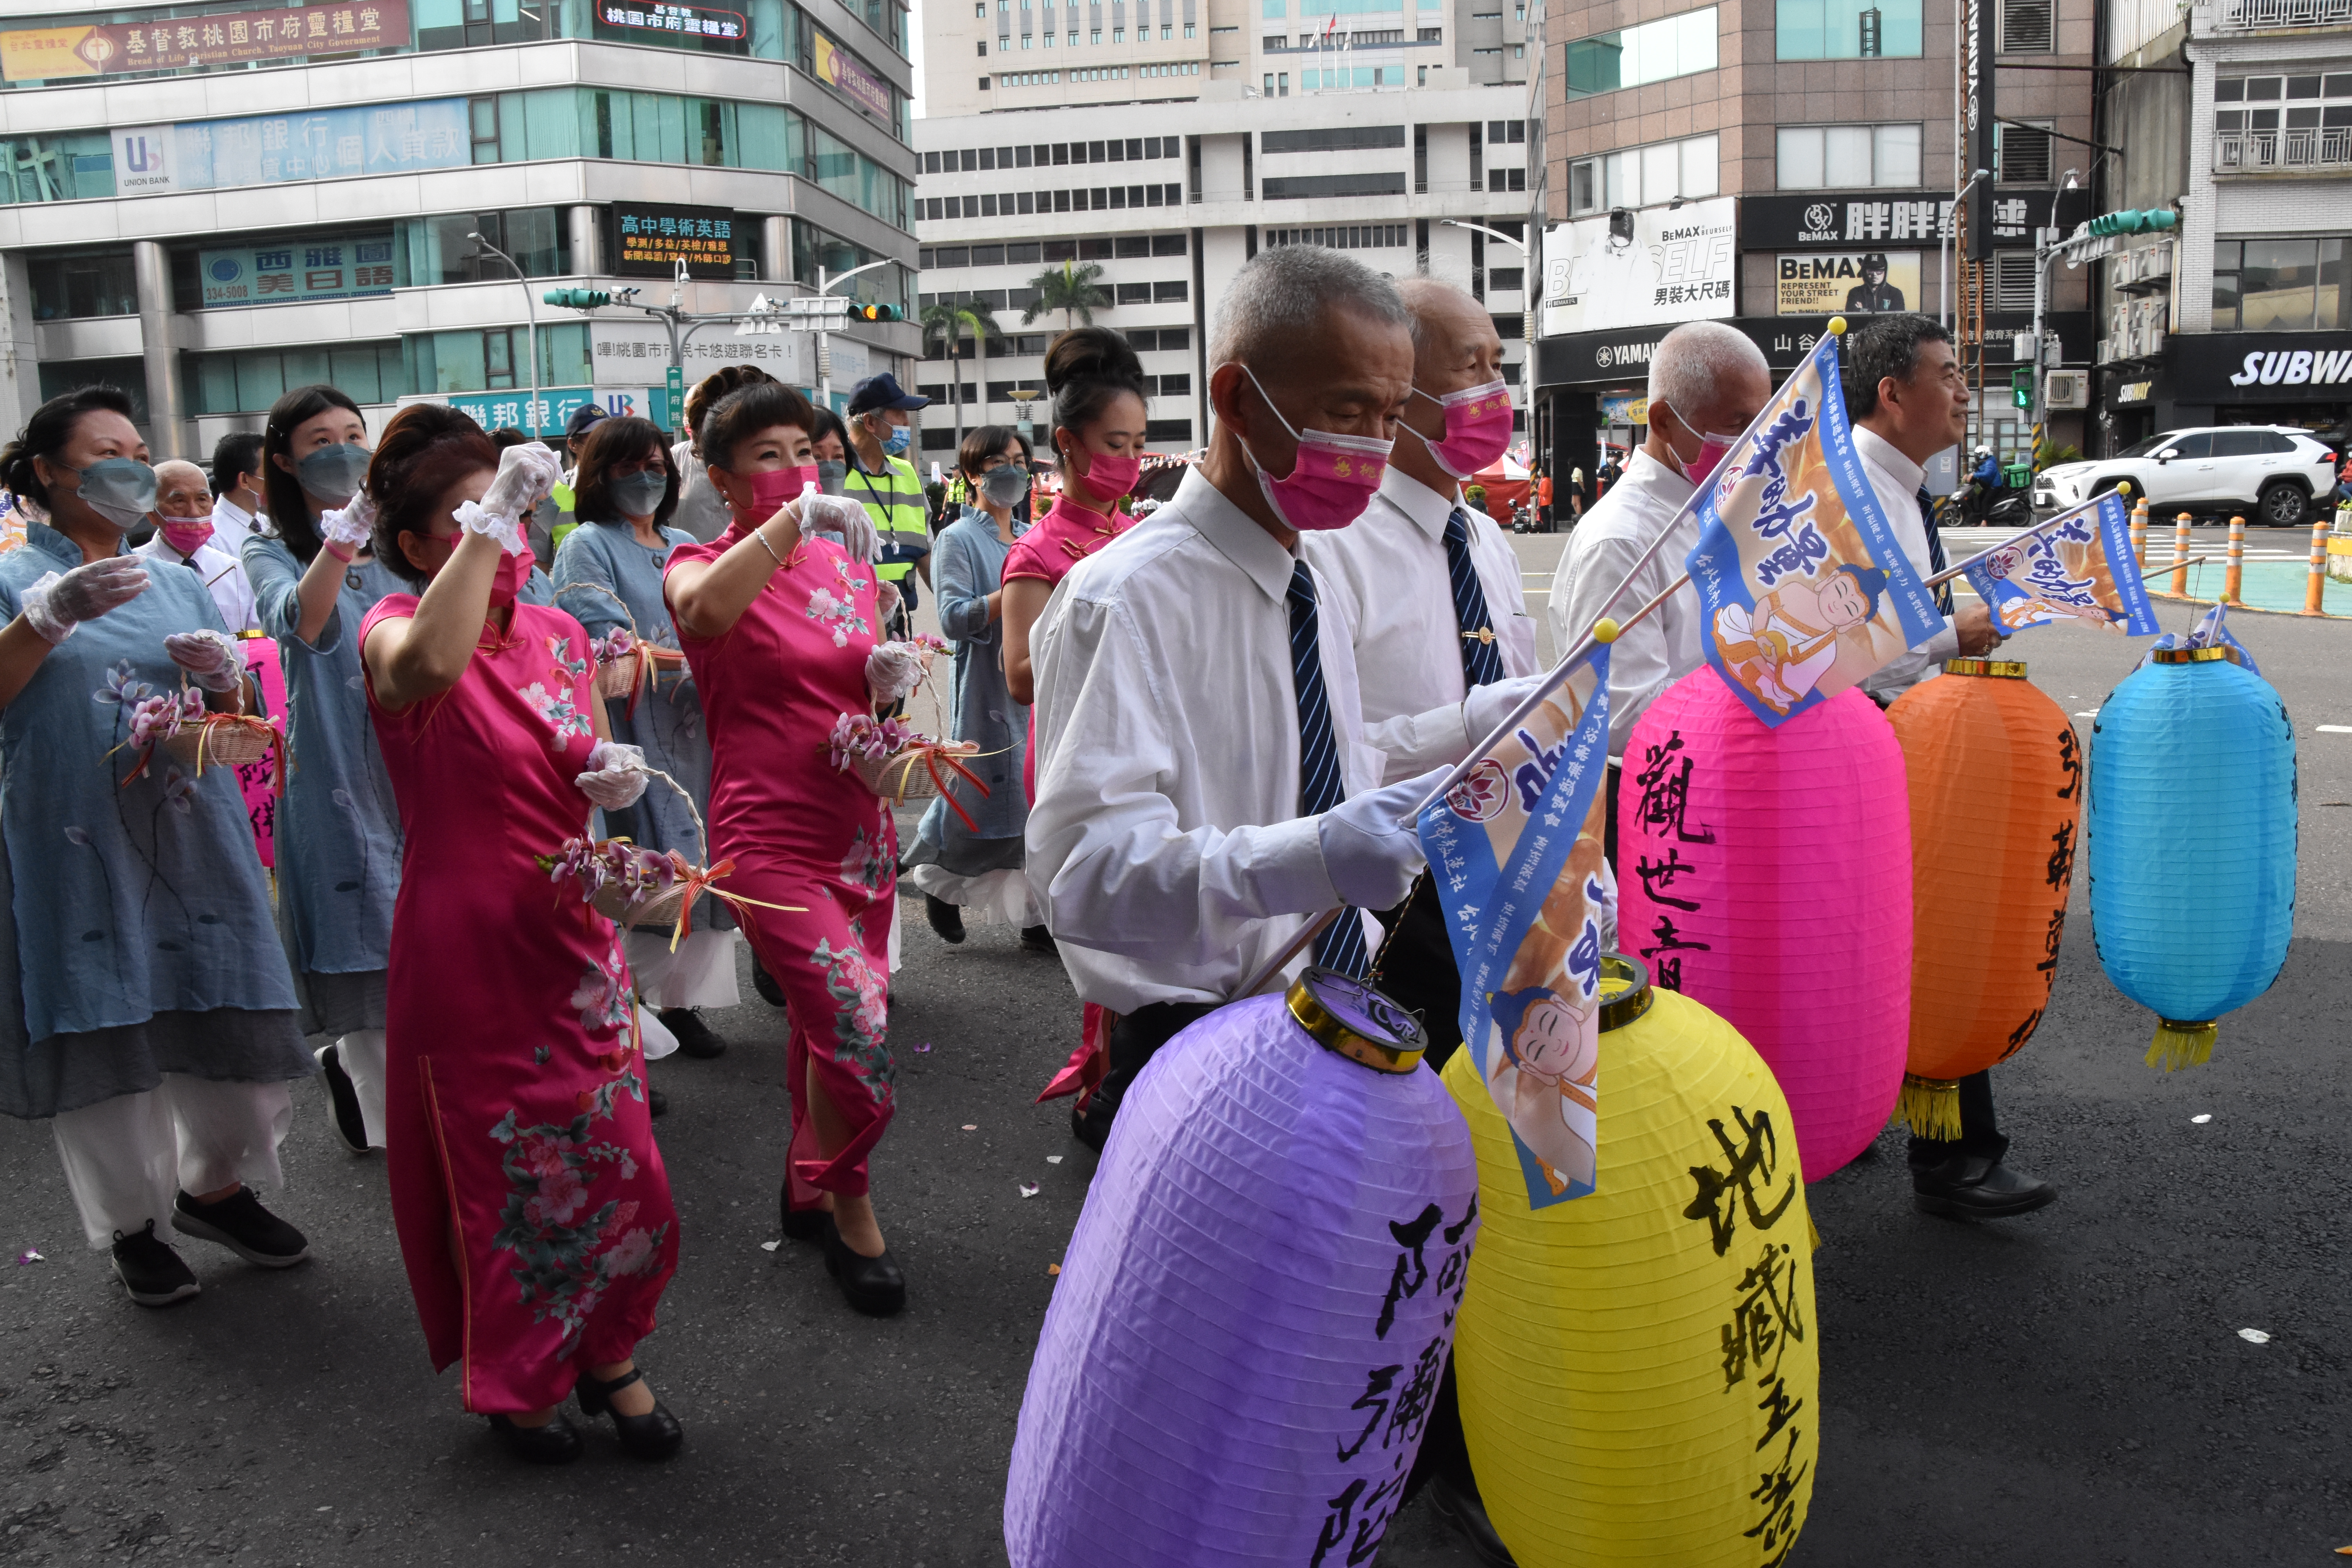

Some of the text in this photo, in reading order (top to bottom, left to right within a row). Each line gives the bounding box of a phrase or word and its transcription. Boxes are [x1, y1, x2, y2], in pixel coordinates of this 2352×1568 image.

[607, 8, 738, 36] 桃園市府靈糧堂
[655, 4, 692, 17] 基督教
[127, 7, 380, 54] 基督教桃園市府靈糧堂
[127, 57, 152, 66] Bread
[169, 54, 184, 62] Life
[189, 51, 227, 60] Christian
[232, 46, 264, 56] Church,
[269, 43, 303, 53] Taoyuan
[307, 40, 324, 49] City
[328, 35, 380, 47] Government
[185, 117, 327, 156] 聯邦銀行
[336, 127, 461, 168] 個人貸款
[124, 176, 169, 187] UNION BANK
[621, 215, 731, 238] 高中學術英語
[1701, 226, 1732, 236] BEURSELF
[255, 243, 391, 271] 西雅圖
[206, 285, 248, 299] 334-5008
[257, 265, 393, 294] 美日語
[1653, 280, 1730, 305] 男裝大尺碼
[670, 379, 680, 421] 縣府路
[1485, 394, 1510, 411] 桃園
[2118, 380, 2152, 403] SUBWAY
[462, 399, 582, 428] 聯邦銀行
